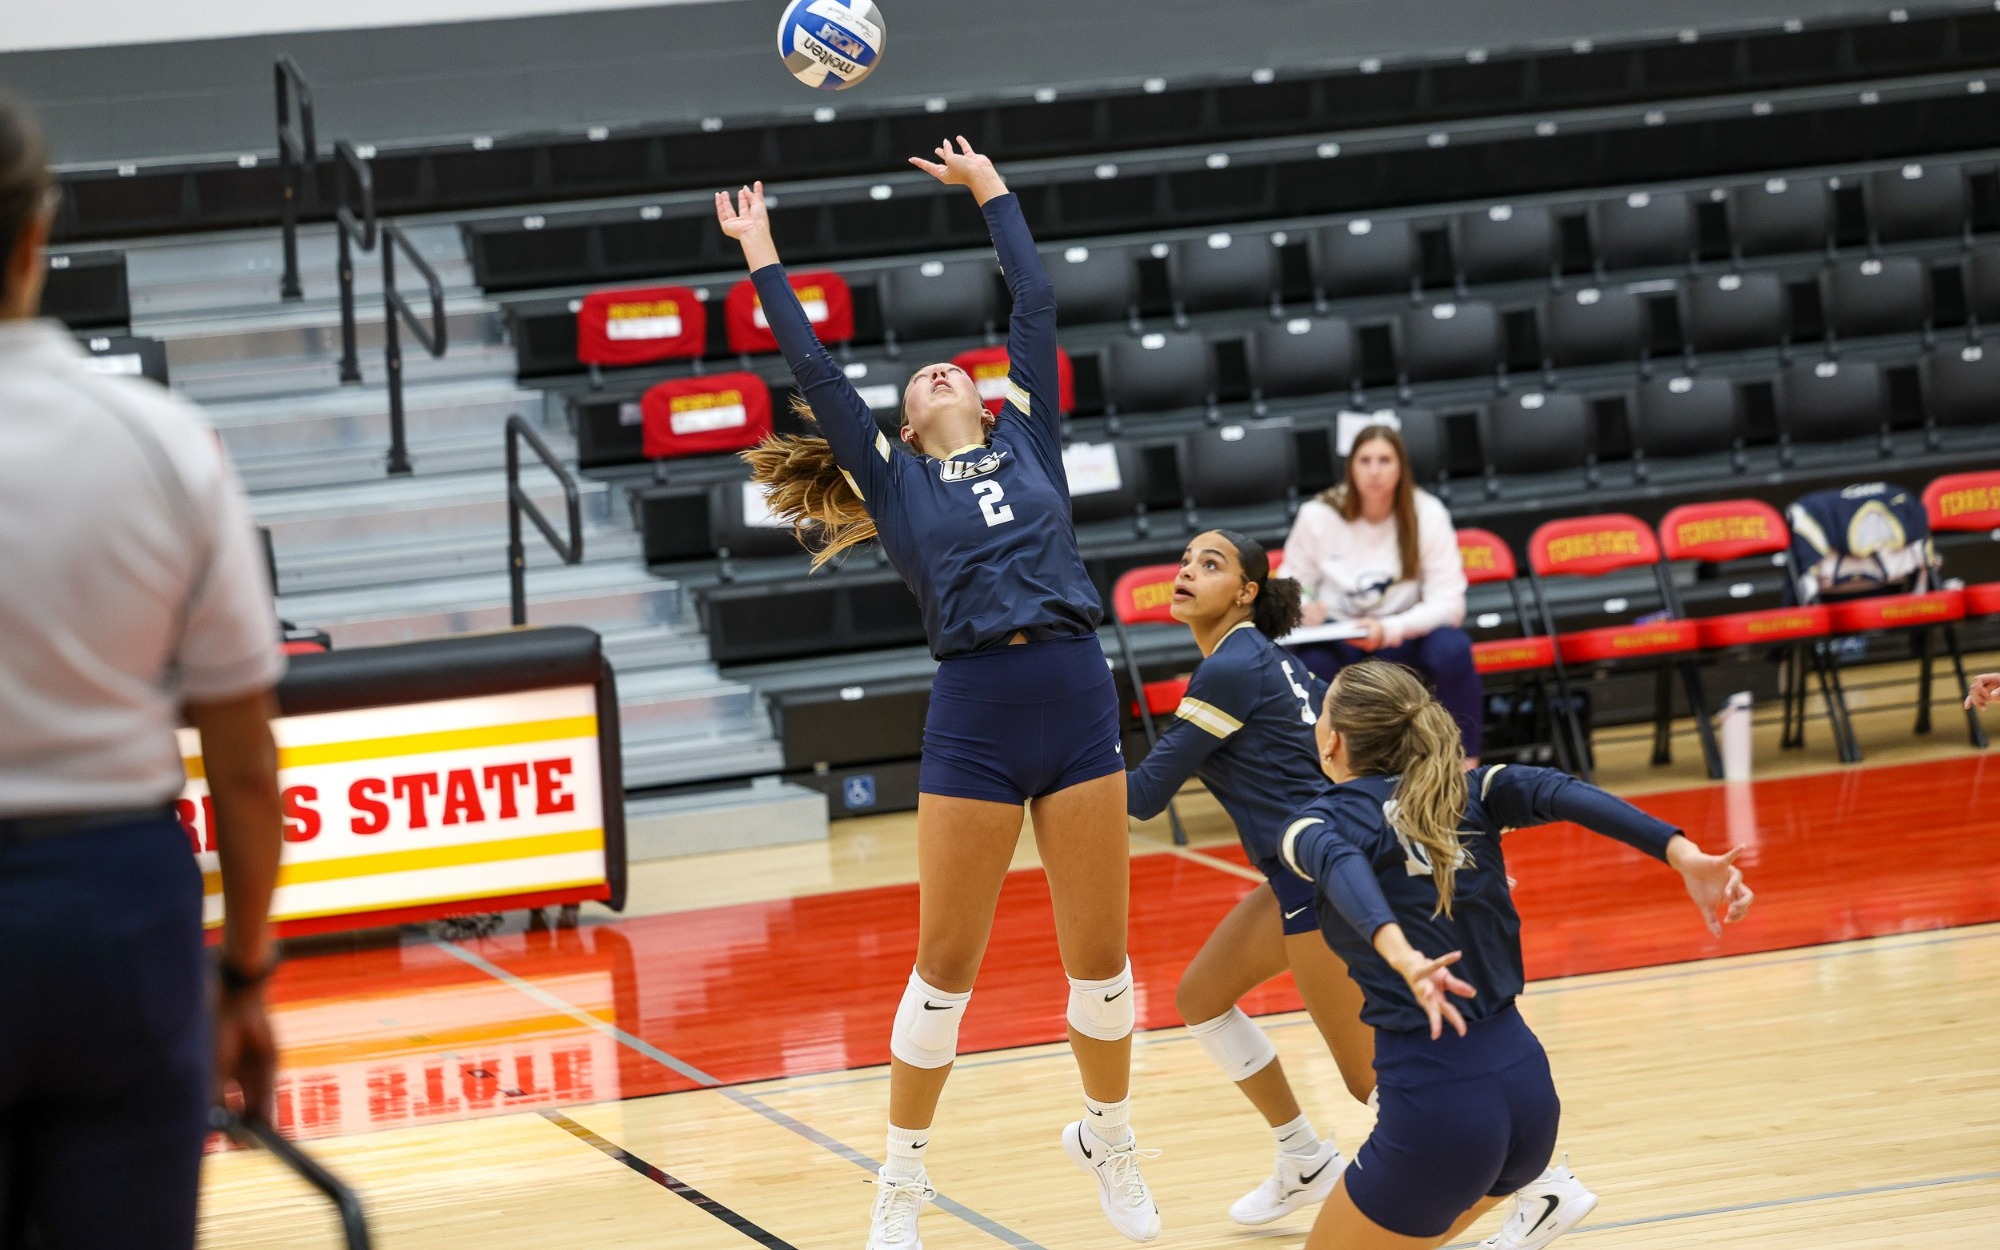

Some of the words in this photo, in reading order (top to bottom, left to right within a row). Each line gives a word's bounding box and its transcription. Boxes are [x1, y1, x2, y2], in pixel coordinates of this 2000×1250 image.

[803, 36, 856, 74] molten
[971, 479, 1015, 528] 2
[1280, 659, 1317, 725] 5
[347, 756, 575, 836] STATE
